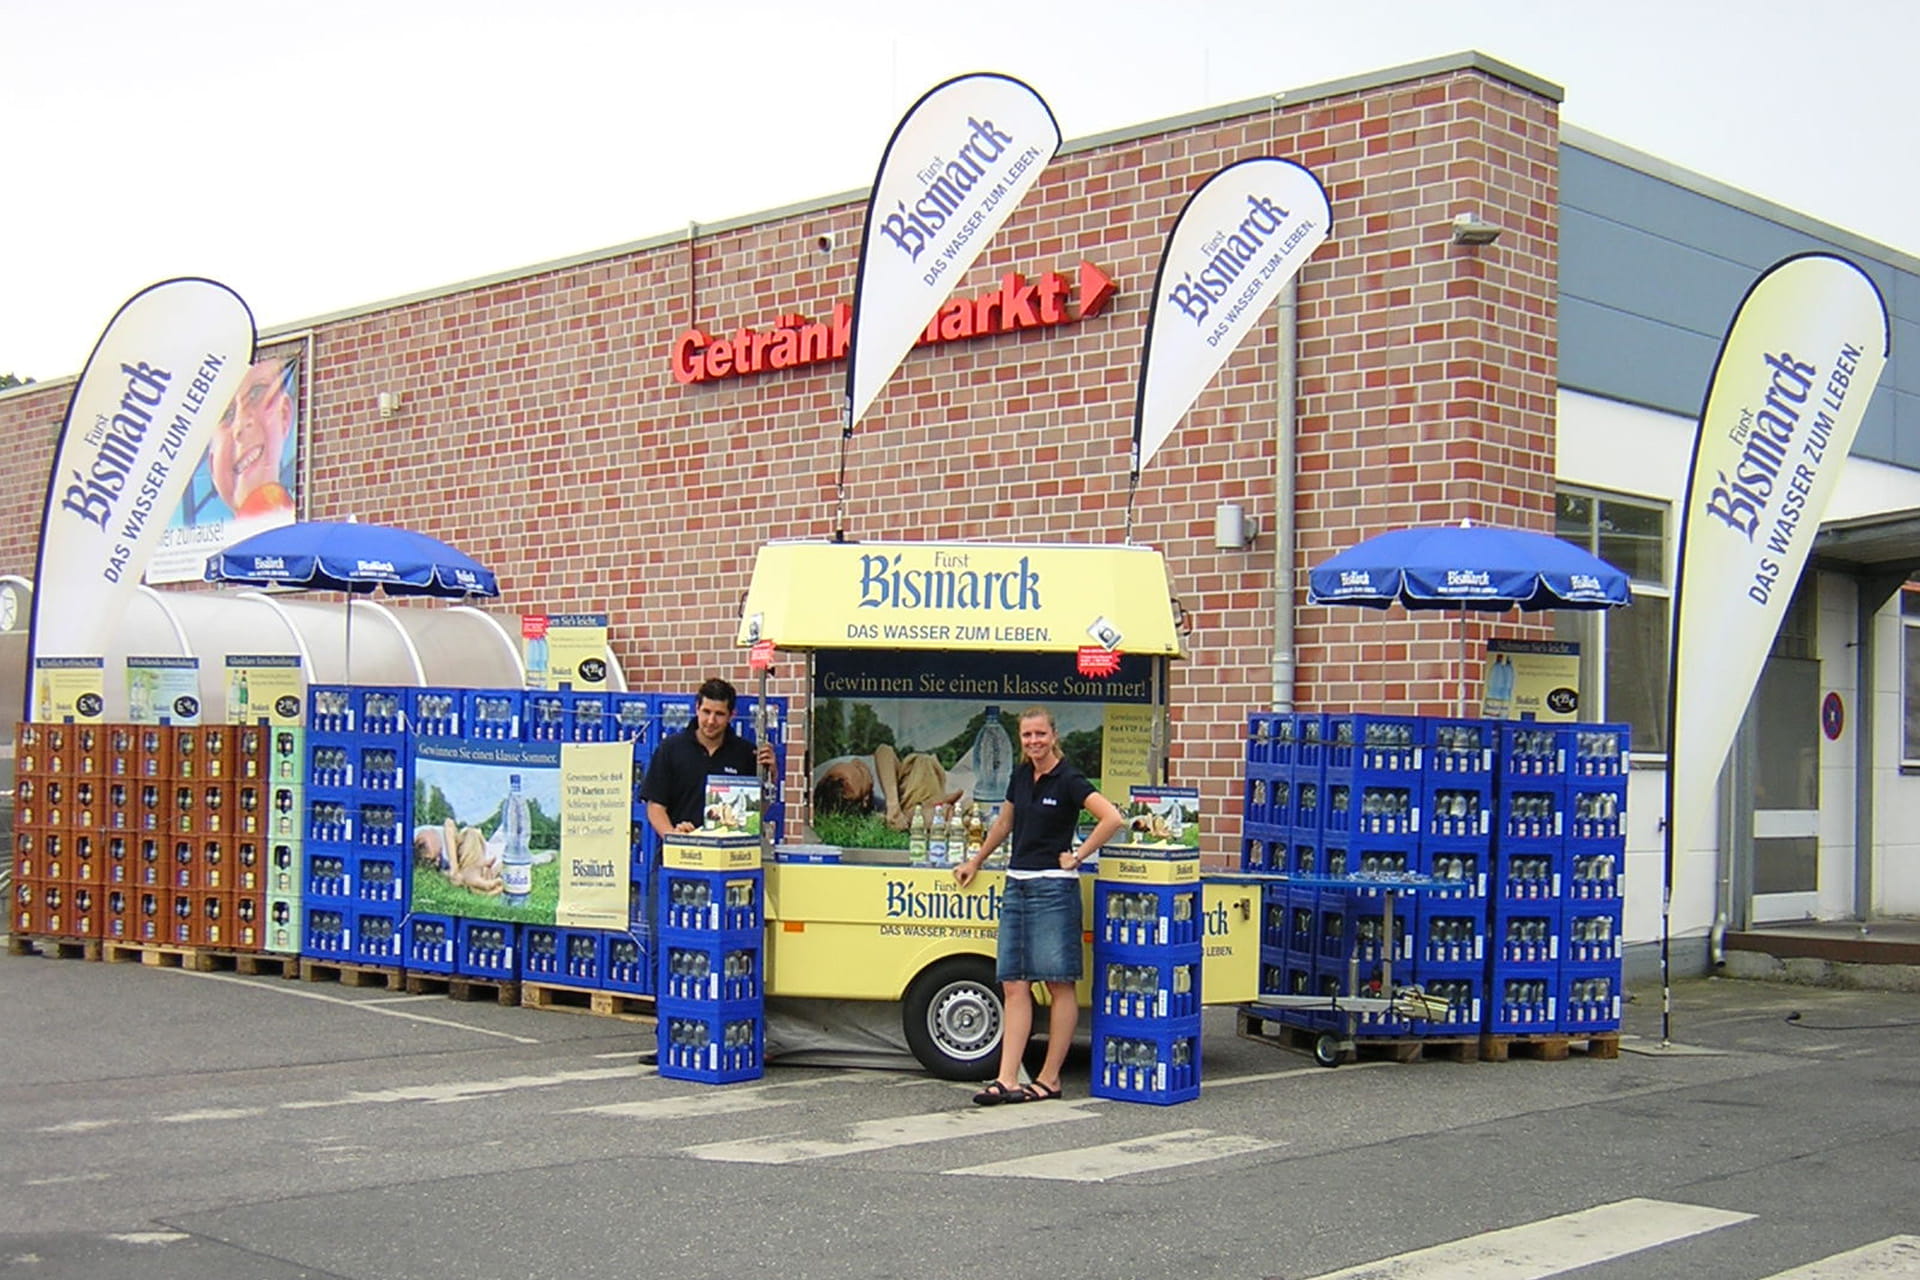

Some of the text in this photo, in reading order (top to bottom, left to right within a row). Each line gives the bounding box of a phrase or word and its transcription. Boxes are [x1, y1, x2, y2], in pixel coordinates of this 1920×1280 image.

[880, 115, 1013, 264] Bismarck
[923, 146, 1043, 286] DAS WASSER ZUM LEBEN.
[1168, 194, 1290, 327] Bismarck
[1206, 220, 1317, 347] DAS WASSER ZUM LEBEN.
[672, 270, 1074, 384] Getränkarkt
[62, 361, 172, 533] Bismarck
[104, 353, 227, 583] DAS WASSER ZUM LEBEN.
[1706, 351, 1817, 544] Bismarck
[1748, 343, 1865, 605] DAS WASSER ZUM LEBEN.
[847, 624, 1052, 642] DAS WASSER ZUM LEBEN.
[858, 553, 1042, 610] Bismarck
[823, 672, 1146, 698] Gewinnen Sie einen klasse Sommer!
[418, 742, 458, 757] Gewinnen
[572, 858, 615, 877] Bismarck
[886, 881, 1003, 920] Bismarck
[880, 925, 999, 939] DAS WASSER ZUM LEBE
